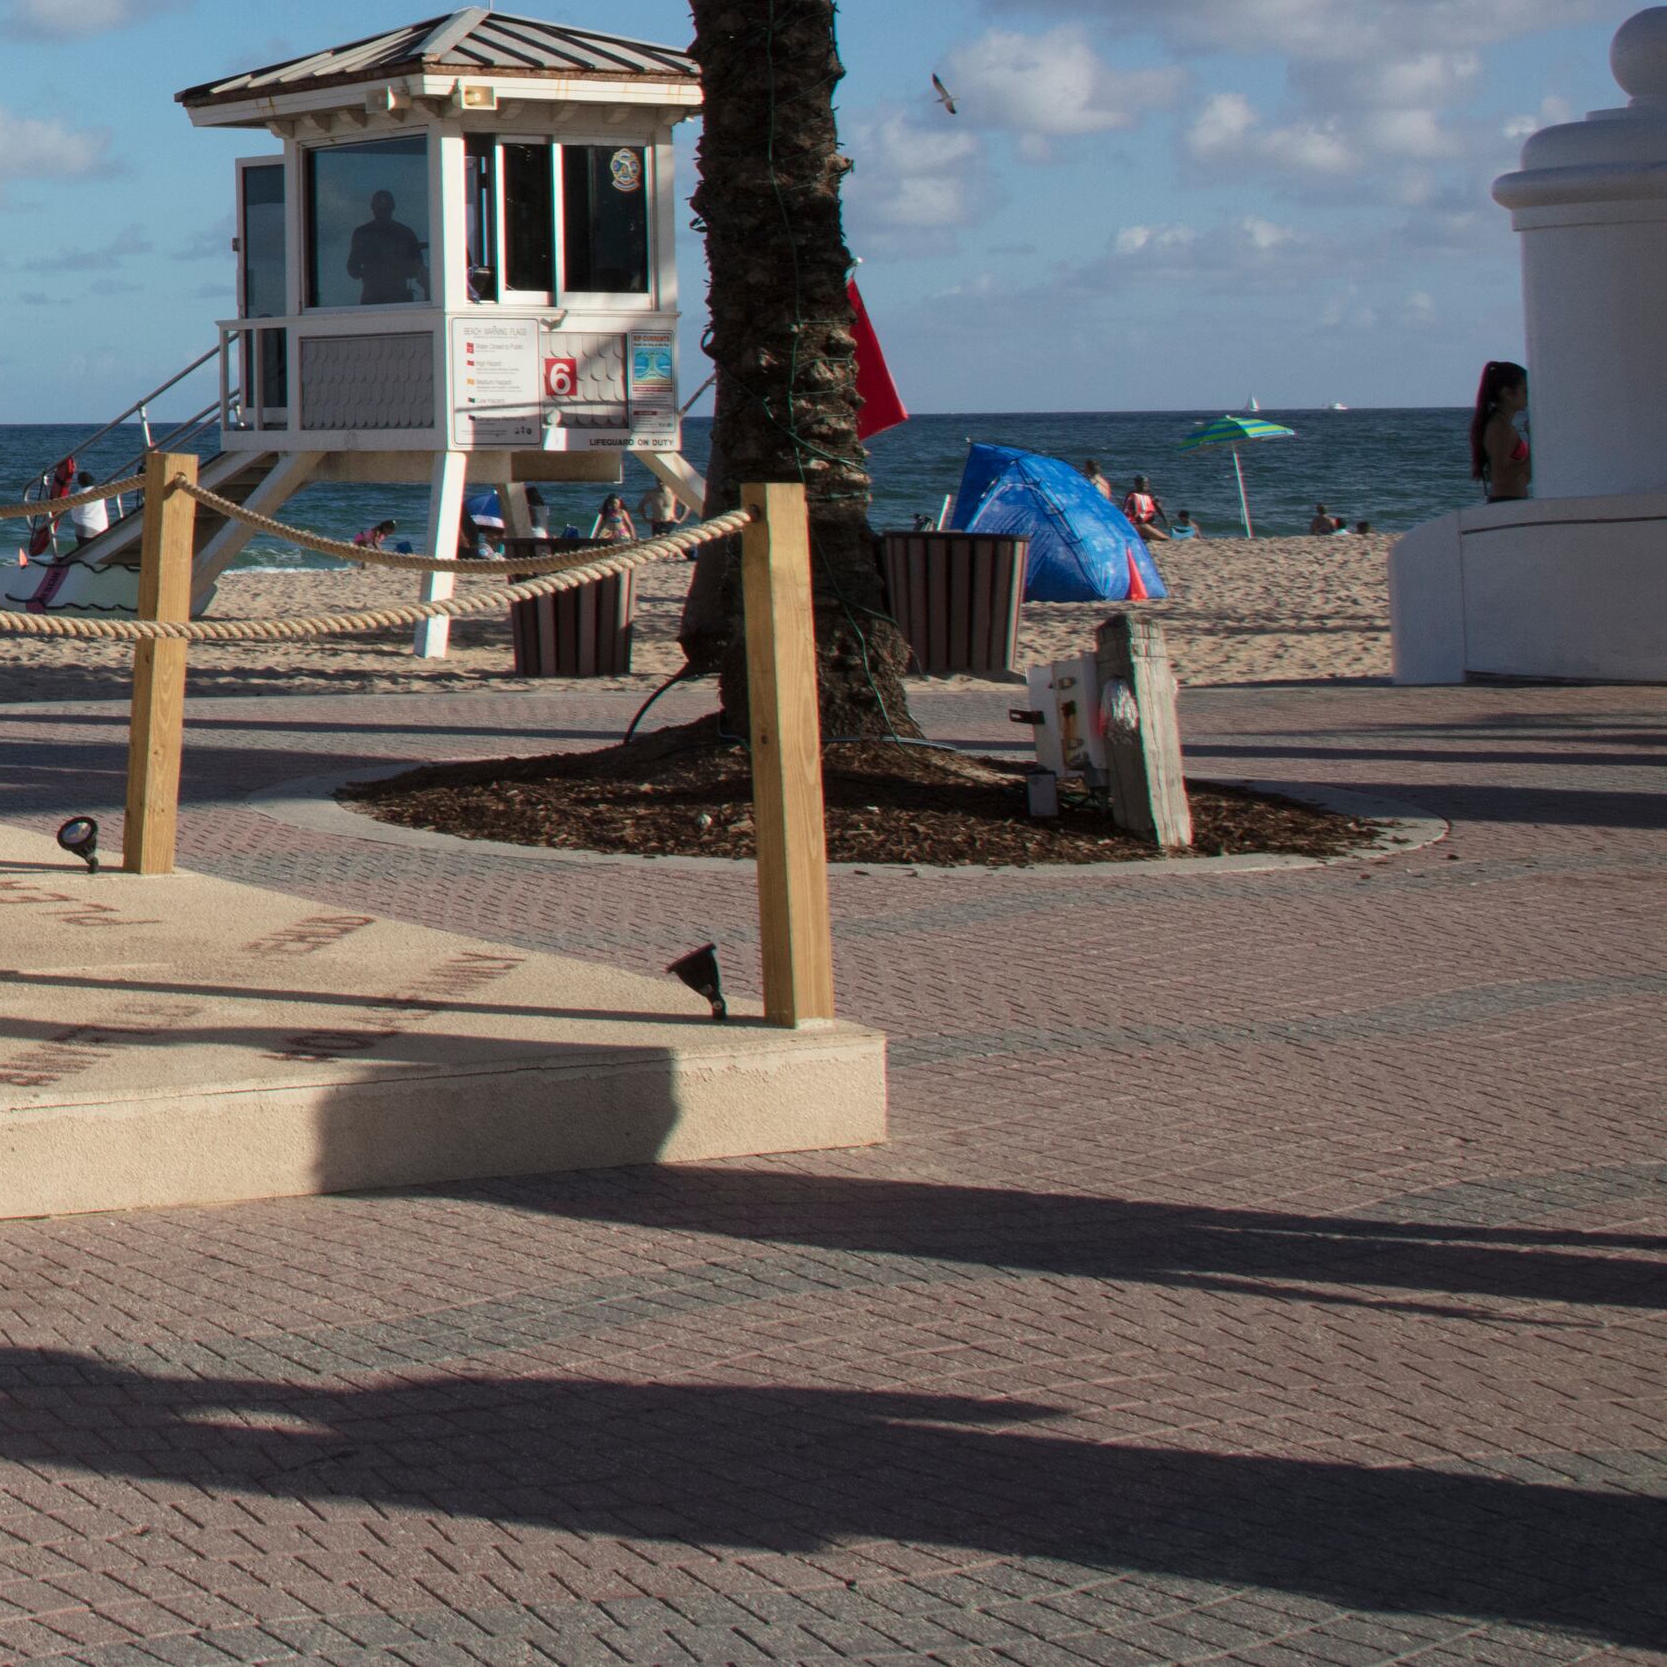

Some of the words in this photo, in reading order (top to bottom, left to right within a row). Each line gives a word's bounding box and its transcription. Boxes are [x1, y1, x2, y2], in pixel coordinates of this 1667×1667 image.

[549, 362, 572, 396] 6
[589, 438, 635, 446] LIFEGUARD
[637, 438, 650, 446] ON
[651, 438, 674, 447] DUTY
